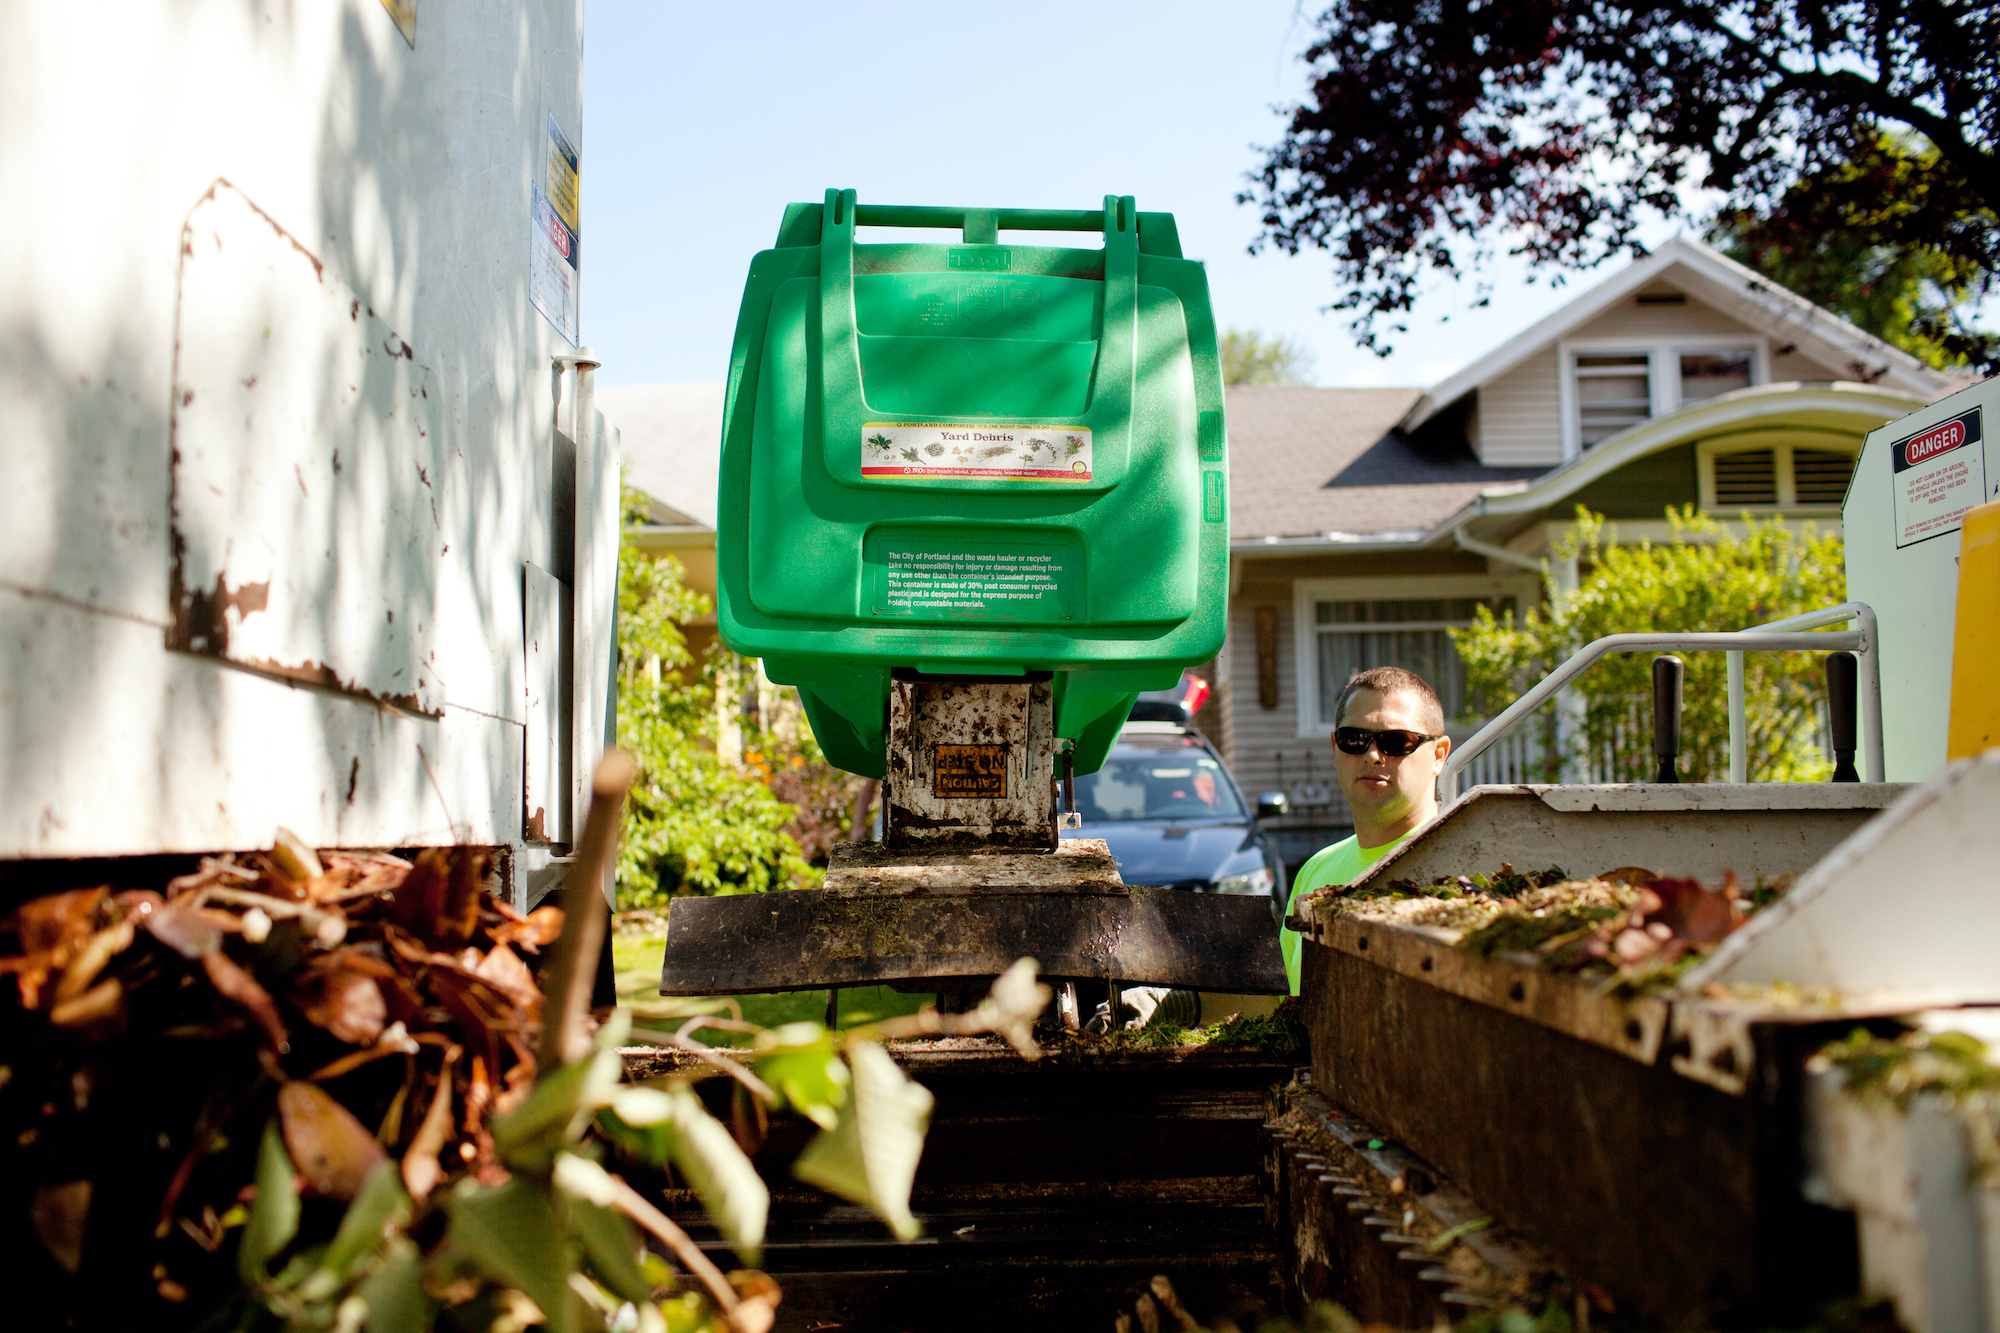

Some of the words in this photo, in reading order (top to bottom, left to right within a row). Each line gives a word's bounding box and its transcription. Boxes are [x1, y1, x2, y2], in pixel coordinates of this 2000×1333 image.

[542, 207, 566, 252] DANGER
[940, 432, 970, 441] Yard
[973, 432, 1014, 442] Debris
[1912, 427, 1958, 460] DANGER
[1924, 472, 1934, 481] CLIMB
[1949, 461, 1965, 471] AROUND
[1916, 482, 1930, 492] VEHICLE
[1931, 477, 1945, 487] UNLESS
[1954, 468, 1969, 478] ENGINE
[1956, 478, 1966, 486] BEEN
[966, 563, 984, 571] injury
[930, 591, 959, 599] designed
[939, 755, 976, 769] STEP
[980, 755, 1005, 770] NO
[942, 778, 999, 789] CAUTION
